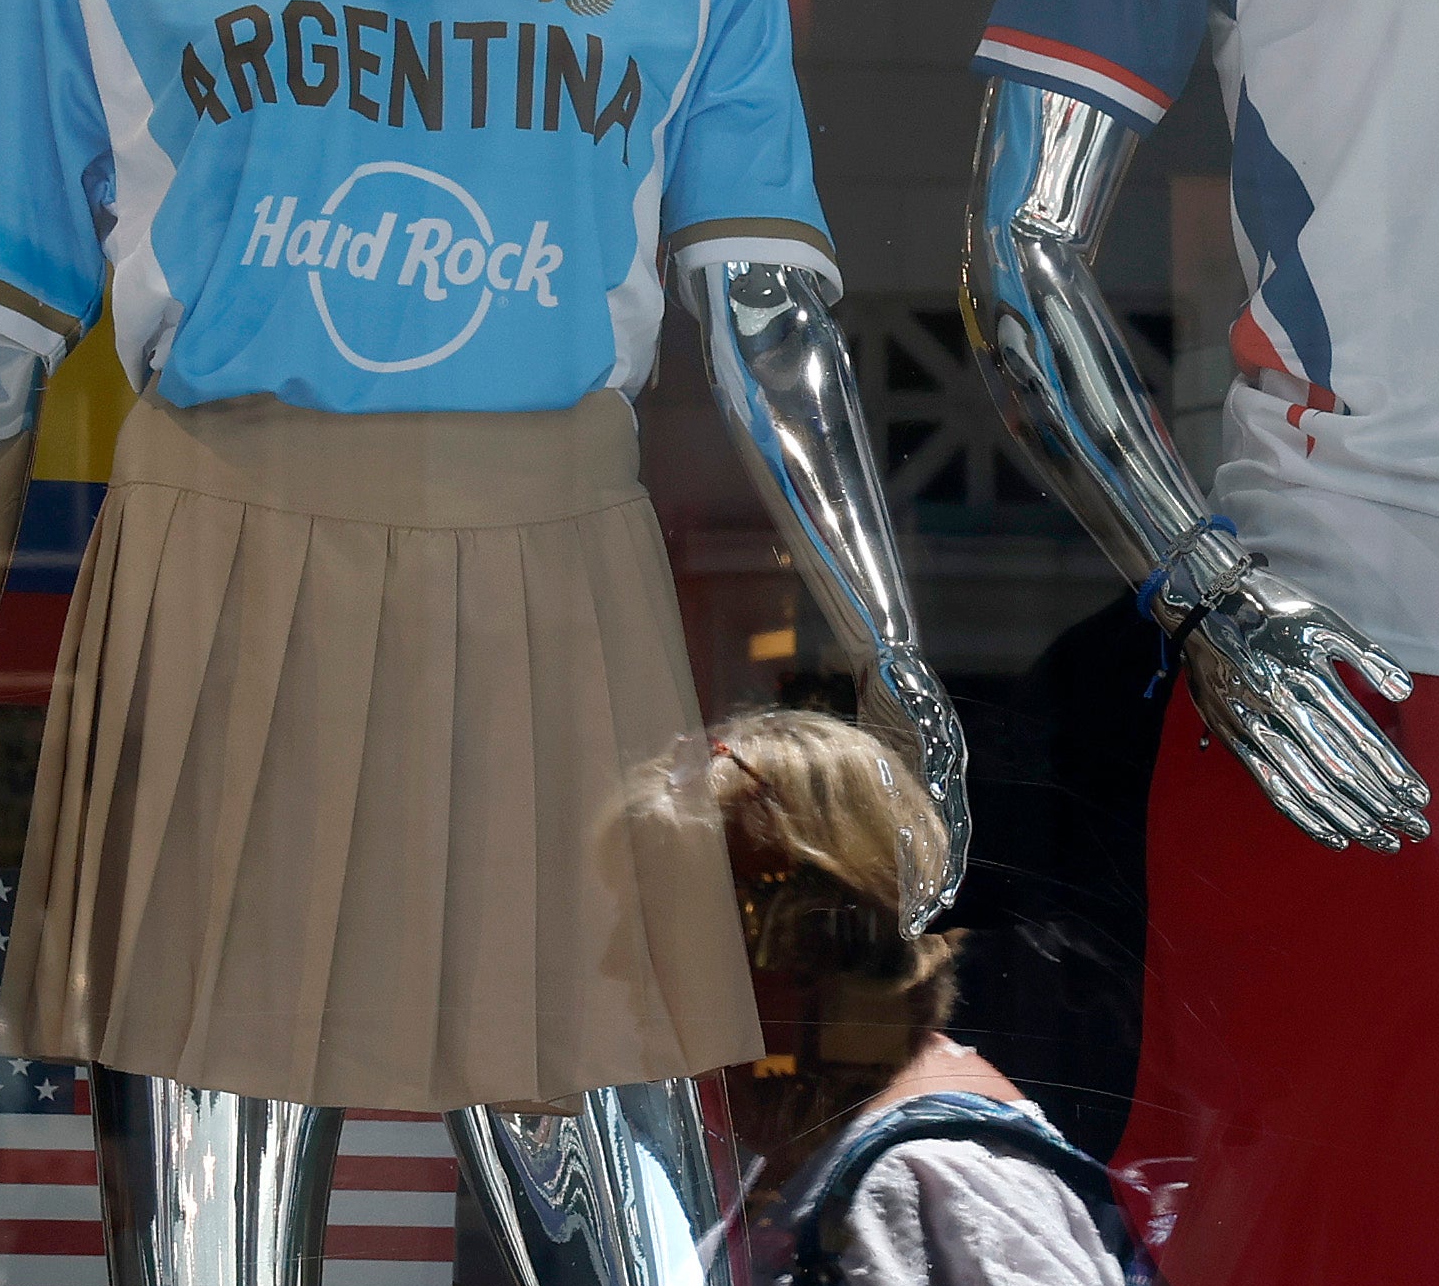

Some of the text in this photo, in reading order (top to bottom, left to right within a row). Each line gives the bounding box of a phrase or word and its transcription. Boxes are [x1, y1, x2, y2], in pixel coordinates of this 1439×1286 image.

[180, 0, 642, 168] ARGENTINA
[242, 195, 565, 309] Hard Rock
